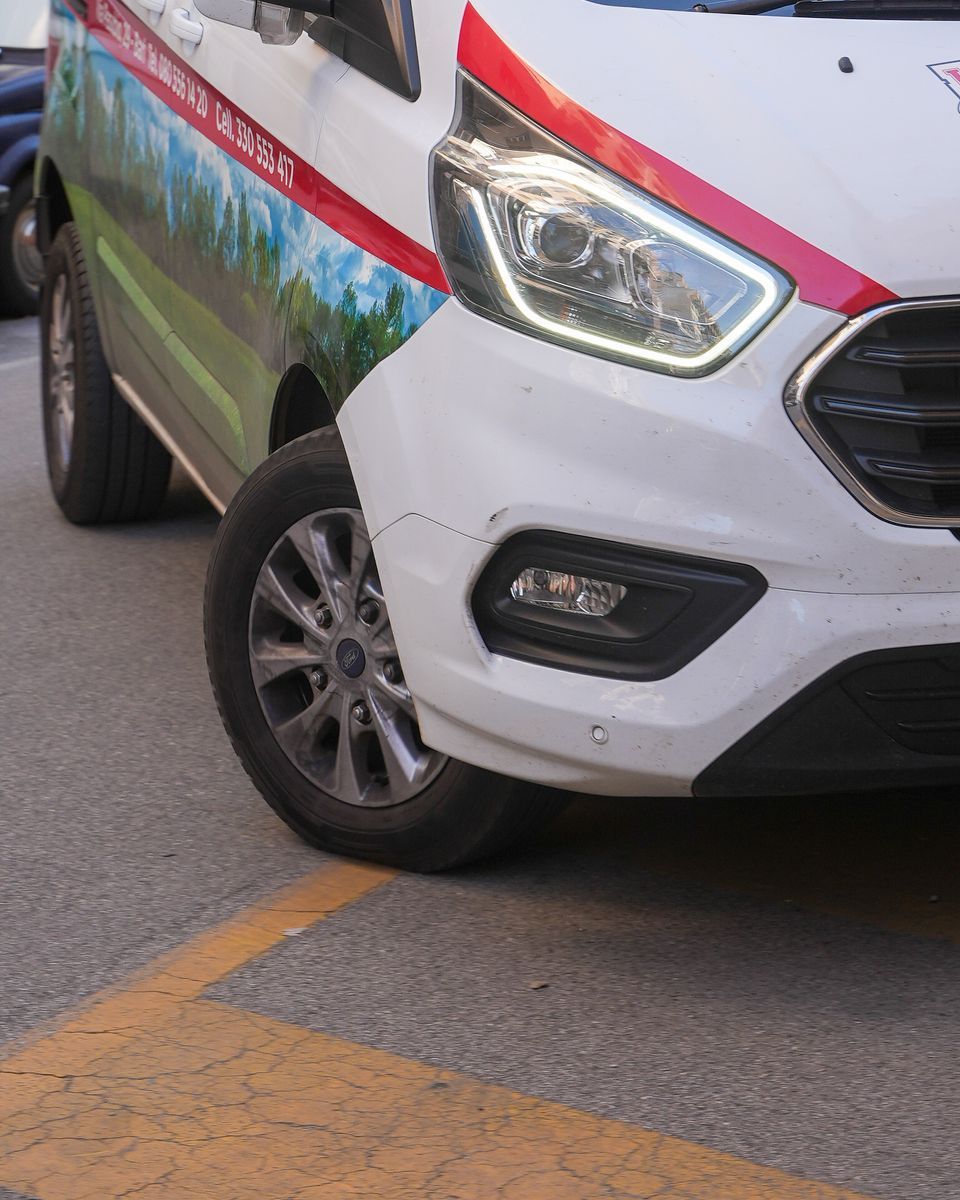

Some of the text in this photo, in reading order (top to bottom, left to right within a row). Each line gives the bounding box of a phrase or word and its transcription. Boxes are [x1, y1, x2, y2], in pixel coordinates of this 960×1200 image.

[187, 76, 196, 109] 14
[196, 84, 208, 118] 20
[216, 100, 235, 142] Cell.
[235, 115, 255, 158] 330
[256, 132, 275, 175] 553
[277, 150, 294, 189] 417
